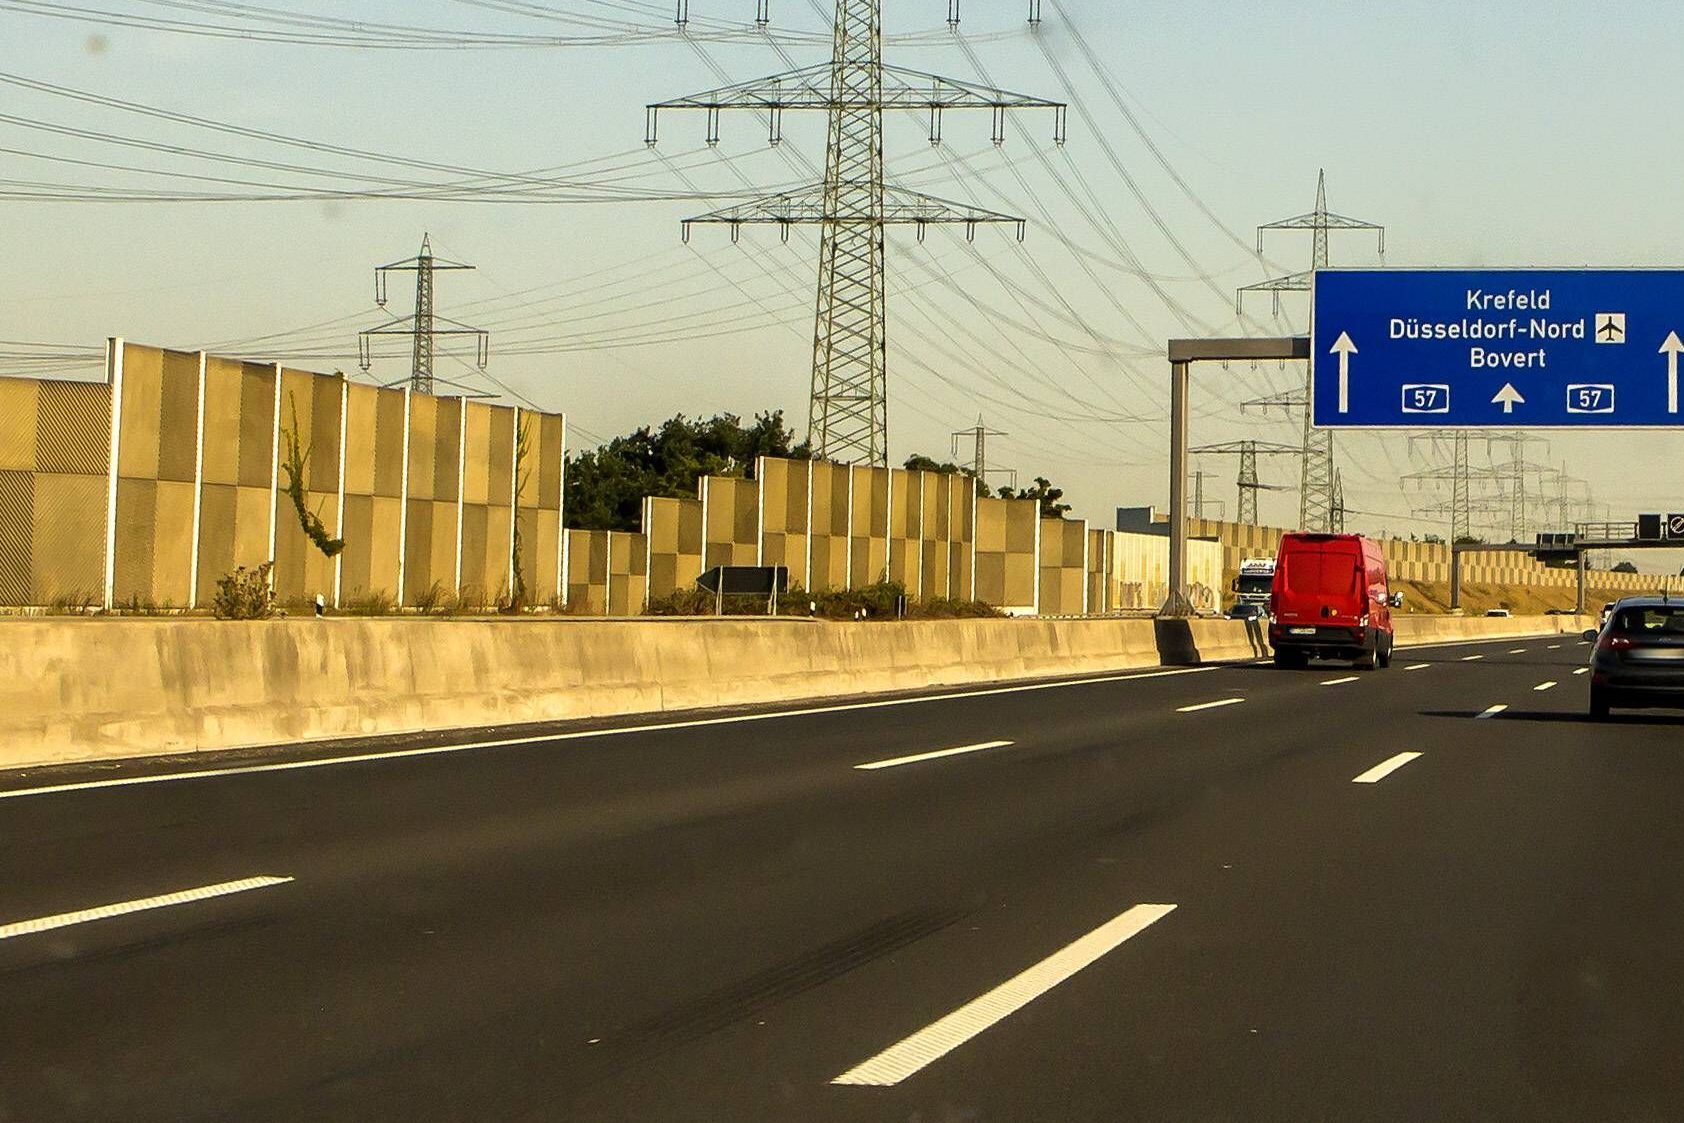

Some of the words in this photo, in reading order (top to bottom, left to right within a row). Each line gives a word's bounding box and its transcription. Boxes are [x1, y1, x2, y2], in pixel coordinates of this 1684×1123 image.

[1467, 290, 1550, 310] Krefeld
[1390, 318, 1585, 339] Düsseldorf-Nord
[1470, 348, 1546, 368] Bovert
[1414, 390, 1436, 408] 57
[1579, 390, 1602, 408] 57
